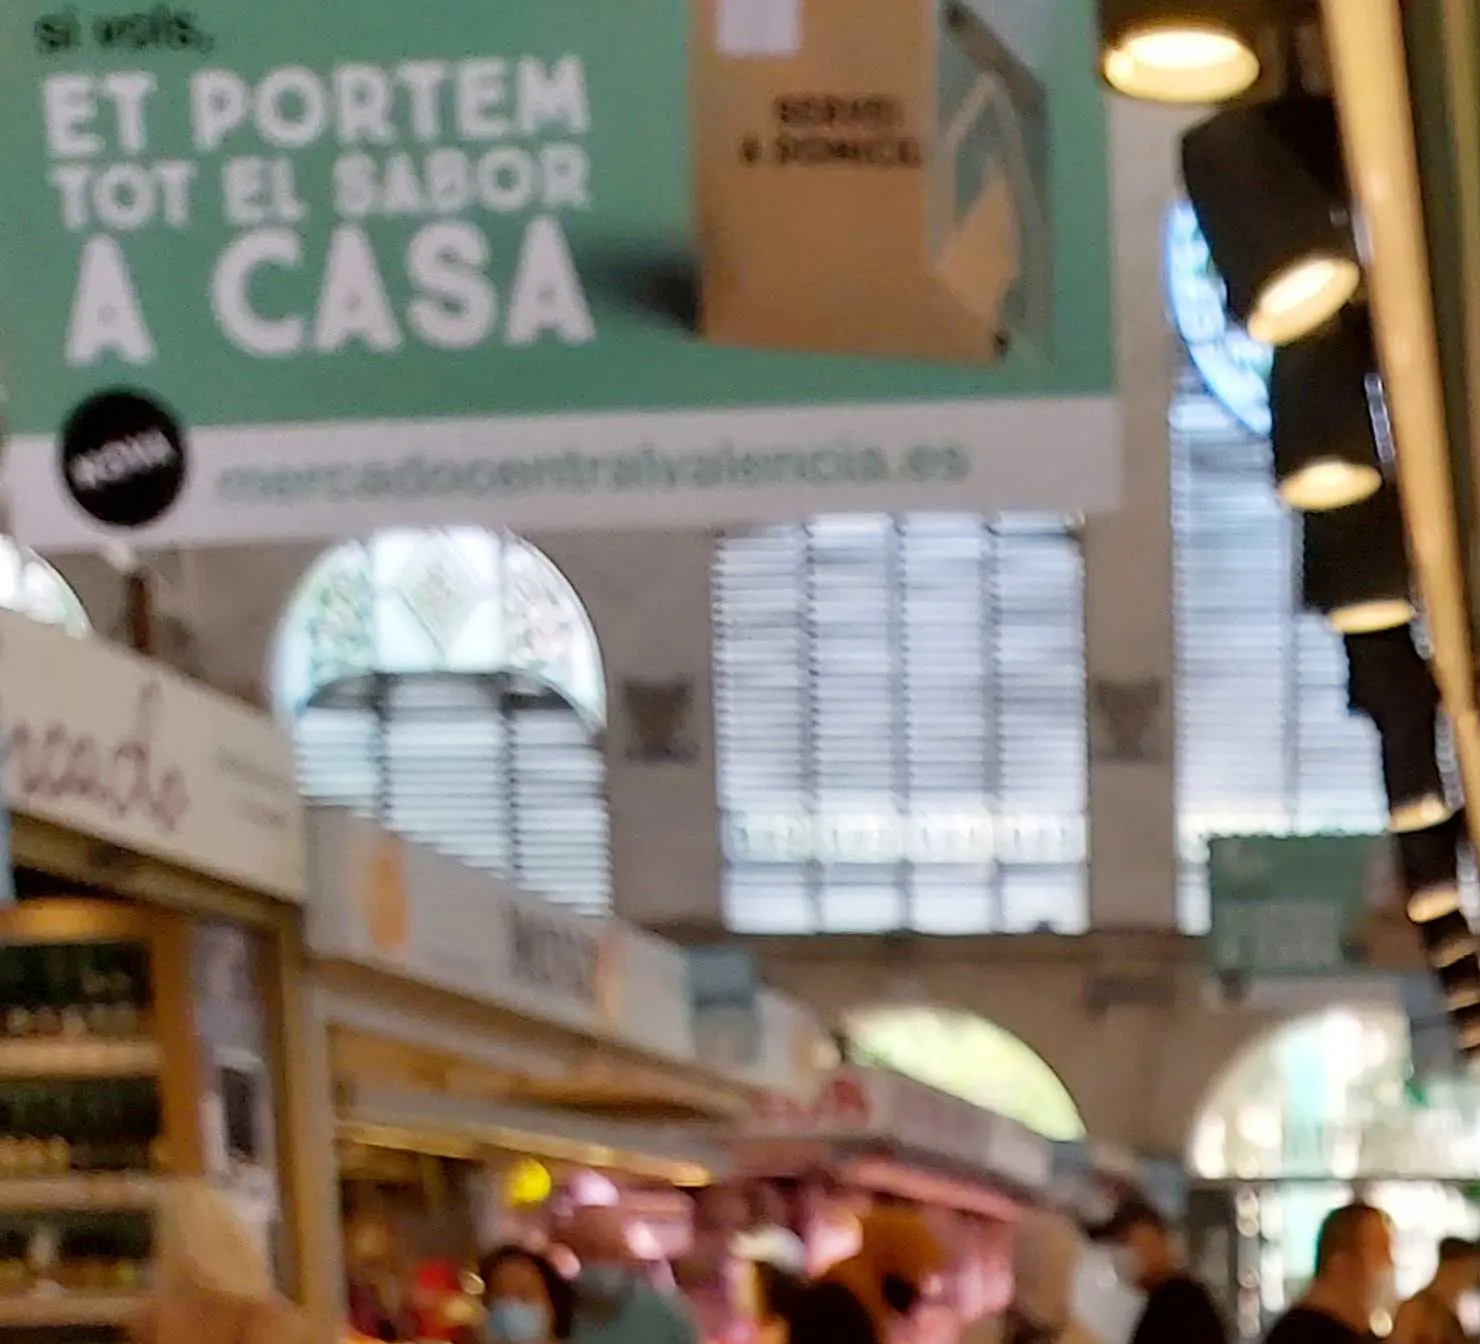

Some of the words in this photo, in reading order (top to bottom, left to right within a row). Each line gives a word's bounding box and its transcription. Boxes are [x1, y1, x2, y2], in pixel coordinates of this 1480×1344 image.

[41, 72, 157, 157] ET
[190, 51, 591, 151] PORTEM
[52, 159, 197, 231] TOT
[221, 154, 306, 225] EL
[332, 143, 592, 218] SABOR
[66, 234, 155, 366] A
[209, 213, 596, 359] CASA
[216, 438, 971, 503] mercadocentralvalencia.es
